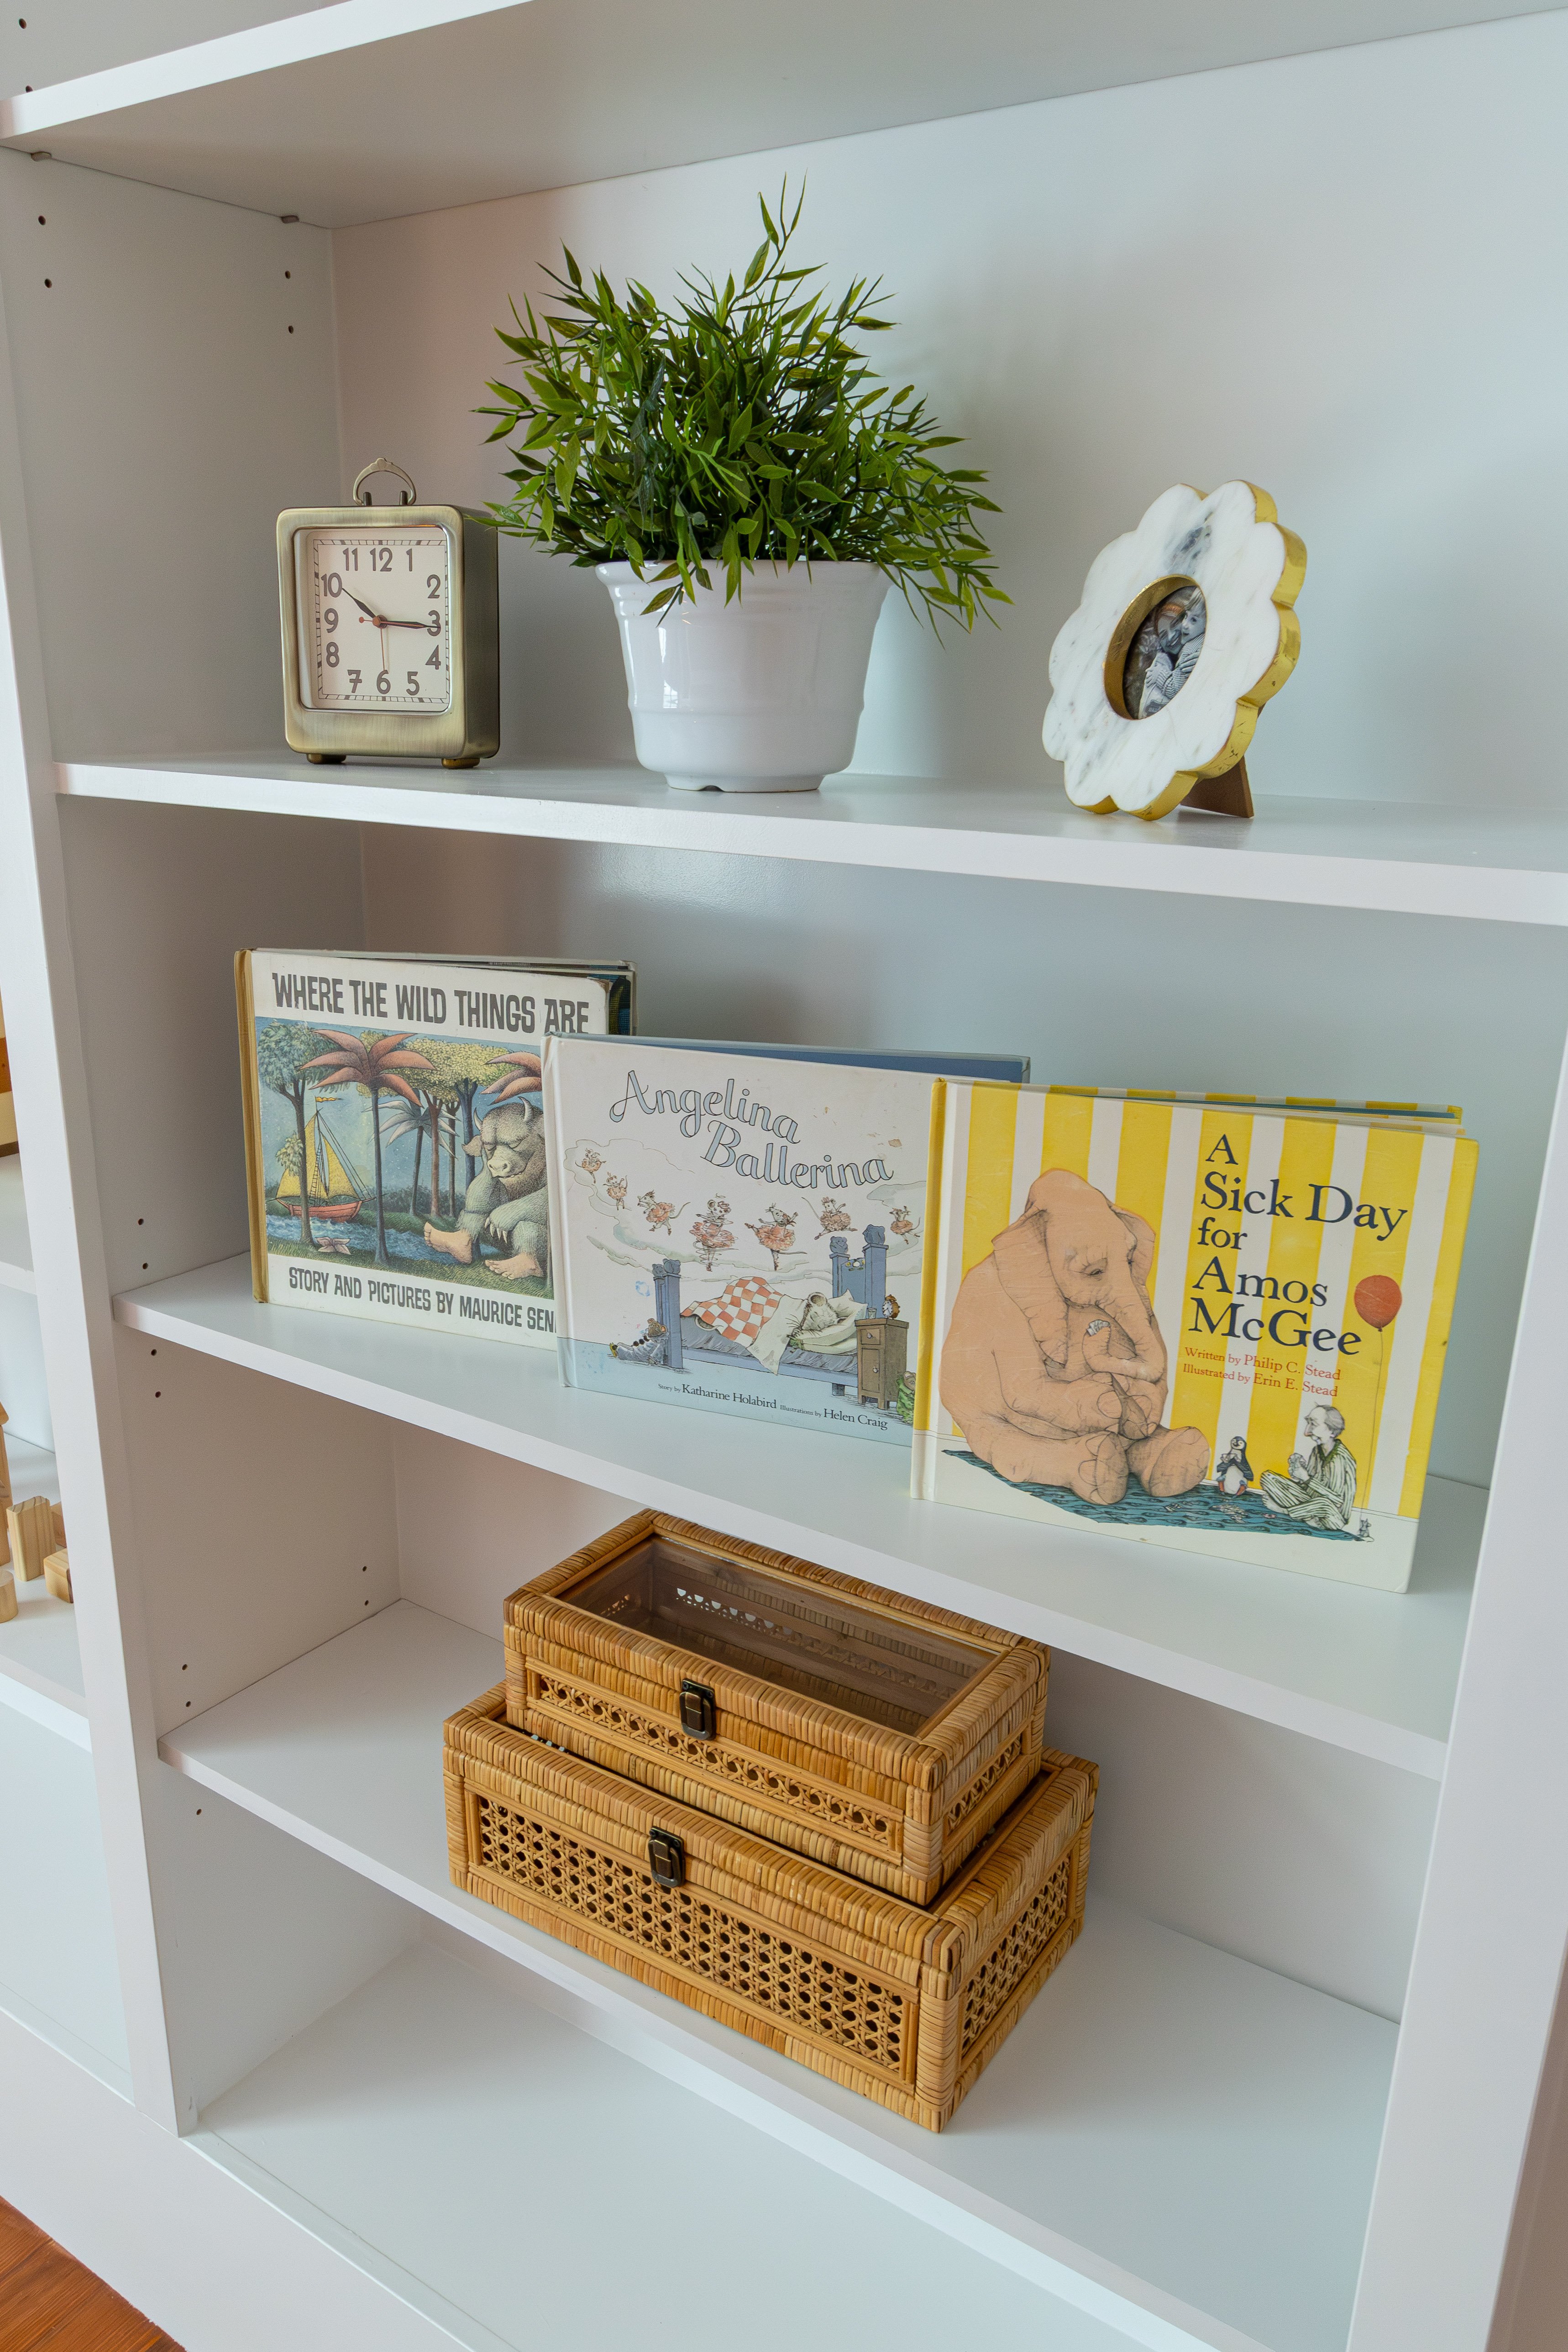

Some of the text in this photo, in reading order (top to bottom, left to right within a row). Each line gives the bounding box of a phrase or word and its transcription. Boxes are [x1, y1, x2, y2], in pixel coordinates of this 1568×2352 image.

[342, 547, 358, 571] 11
[369, 547, 393, 572] 12
[406, 548, 413, 572] 1
[321, 572, 342, 598] 10
[427, 574, 441, 599] 2
[324, 608, 339, 633] 9
[427, 610, 441, 636] 3
[326, 641, 340, 667] 8
[425, 645, 441, 670] 4
[347, 670, 362, 693] 7
[376, 669, 391, 694] 6
[406, 671, 420, 695] 5
[272, 973, 589, 1034] WHERE THE WILD THINGS ARE
[609, 1071, 800, 1144] Angelina
[700, 1120, 894, 1188] Ballerina
[1205, 1134, 1238, 1165] A
[1201, 1171, 1408, 1241] Sick Day
[1197, 1217, 1248, 1250] for
[1192, 1256, 1328, 1307] Amos
[289, 1267, 556, 1333] STORY AND PICTURES BY MAURICE SEN
[1188, 1297, 1362, 1355] McGee
[1185, 1347, 1341, 1380] Written by Philip C. Stead
[1183, 1364, 1338, 1396] Illustrated by Erin E. Stead
[658, 1384, 672, 1392] Story
[682, 1384, 730, 1401] Katharine
[733, 1392, 777, 1409] Holabird
[780, 1405, 813, 1416] Illustrations
[823, 1408, 855, 1423] Helen
[858, 1414, 888, 1431] Craig
